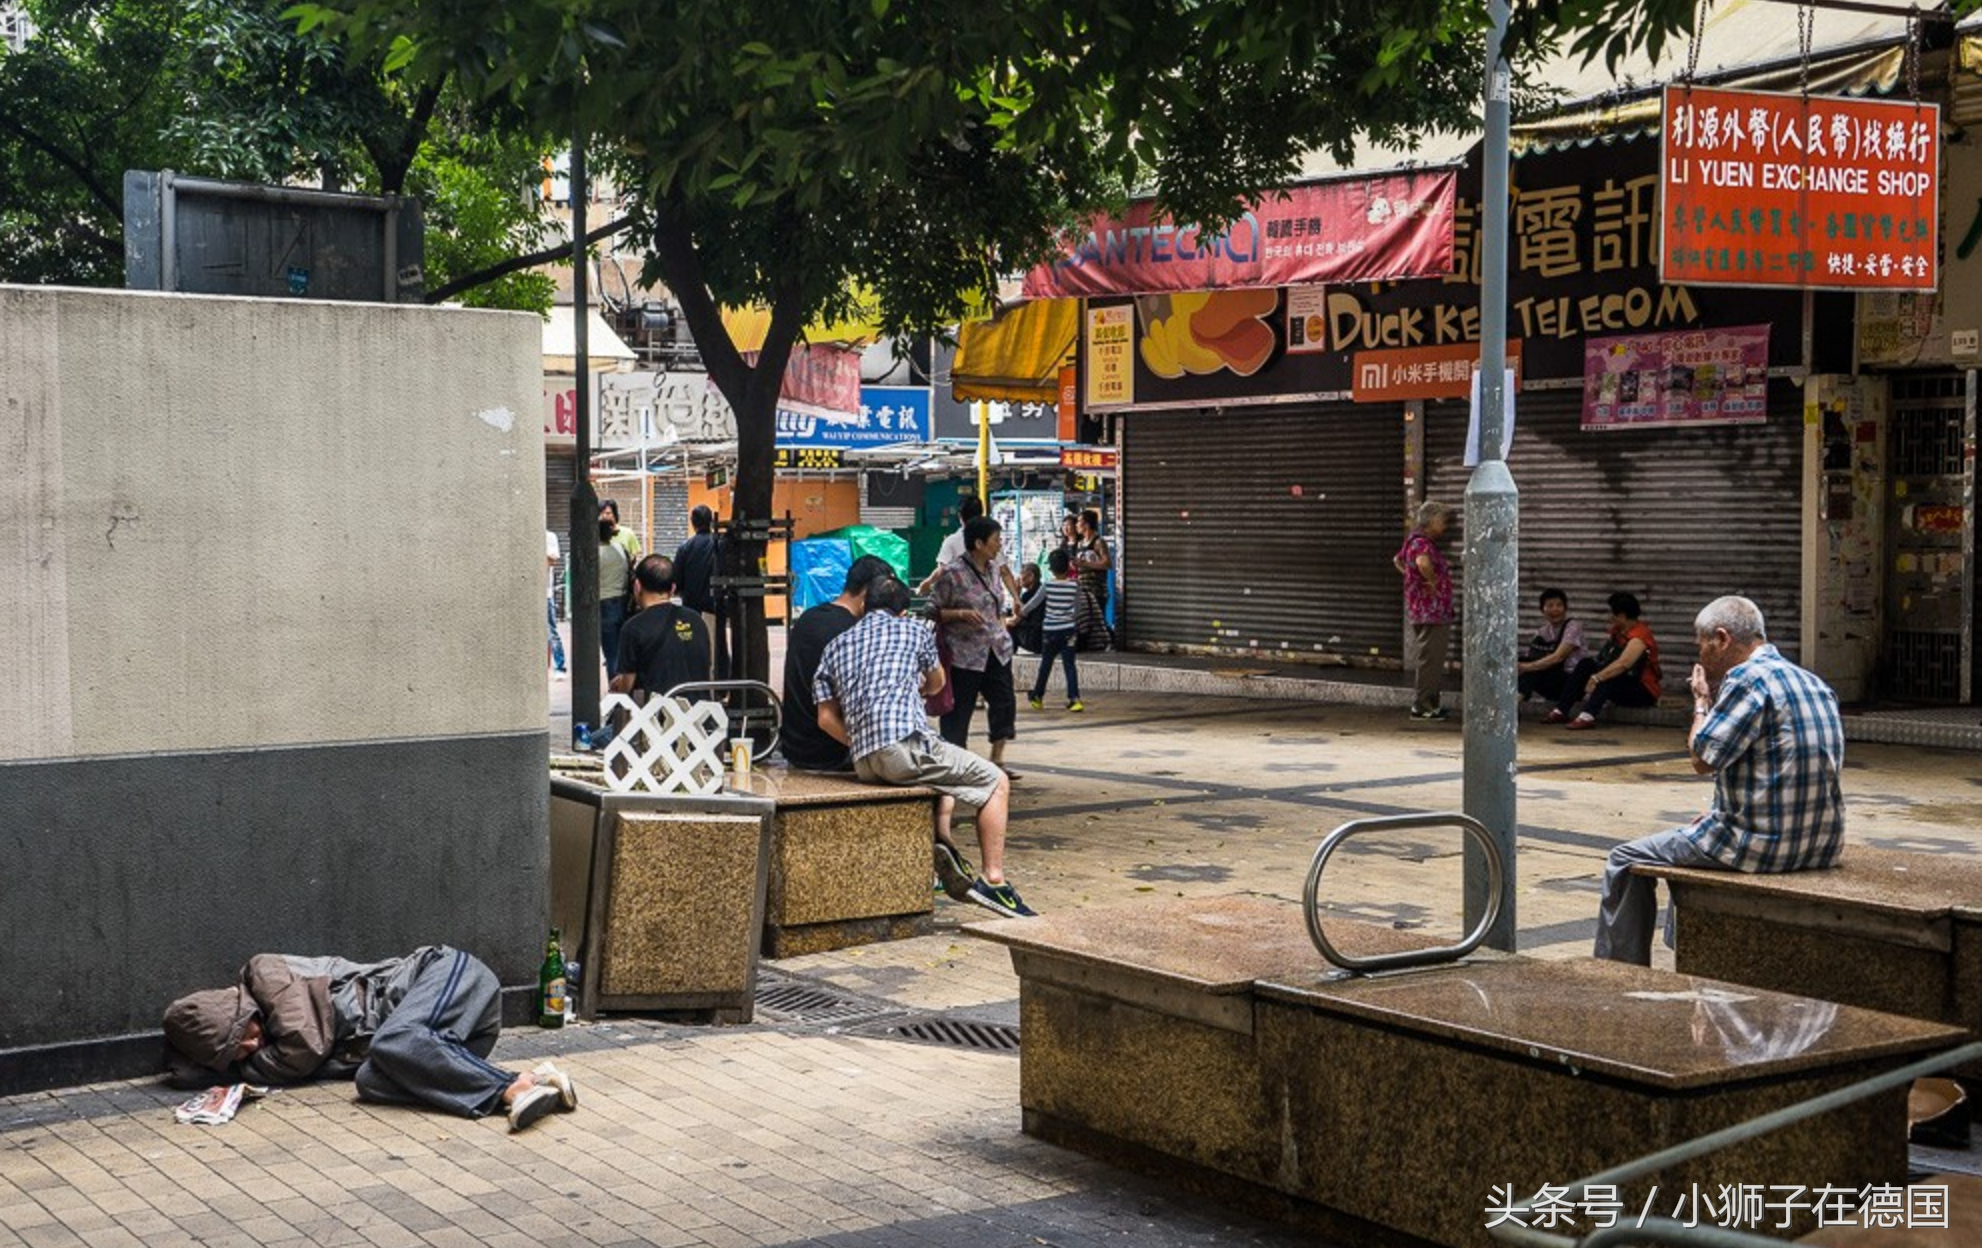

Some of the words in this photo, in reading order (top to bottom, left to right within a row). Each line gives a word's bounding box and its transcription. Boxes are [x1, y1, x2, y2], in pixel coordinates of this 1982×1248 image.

[1671, 158, 1689, 184] LI
[1699, 159, 1753, 188] YUEN
[1762, 163, 1869, 194] EXCHANGE
[1877, 170, 1931, 197] SHOP
[1434, 303, 1481, 346] KE
